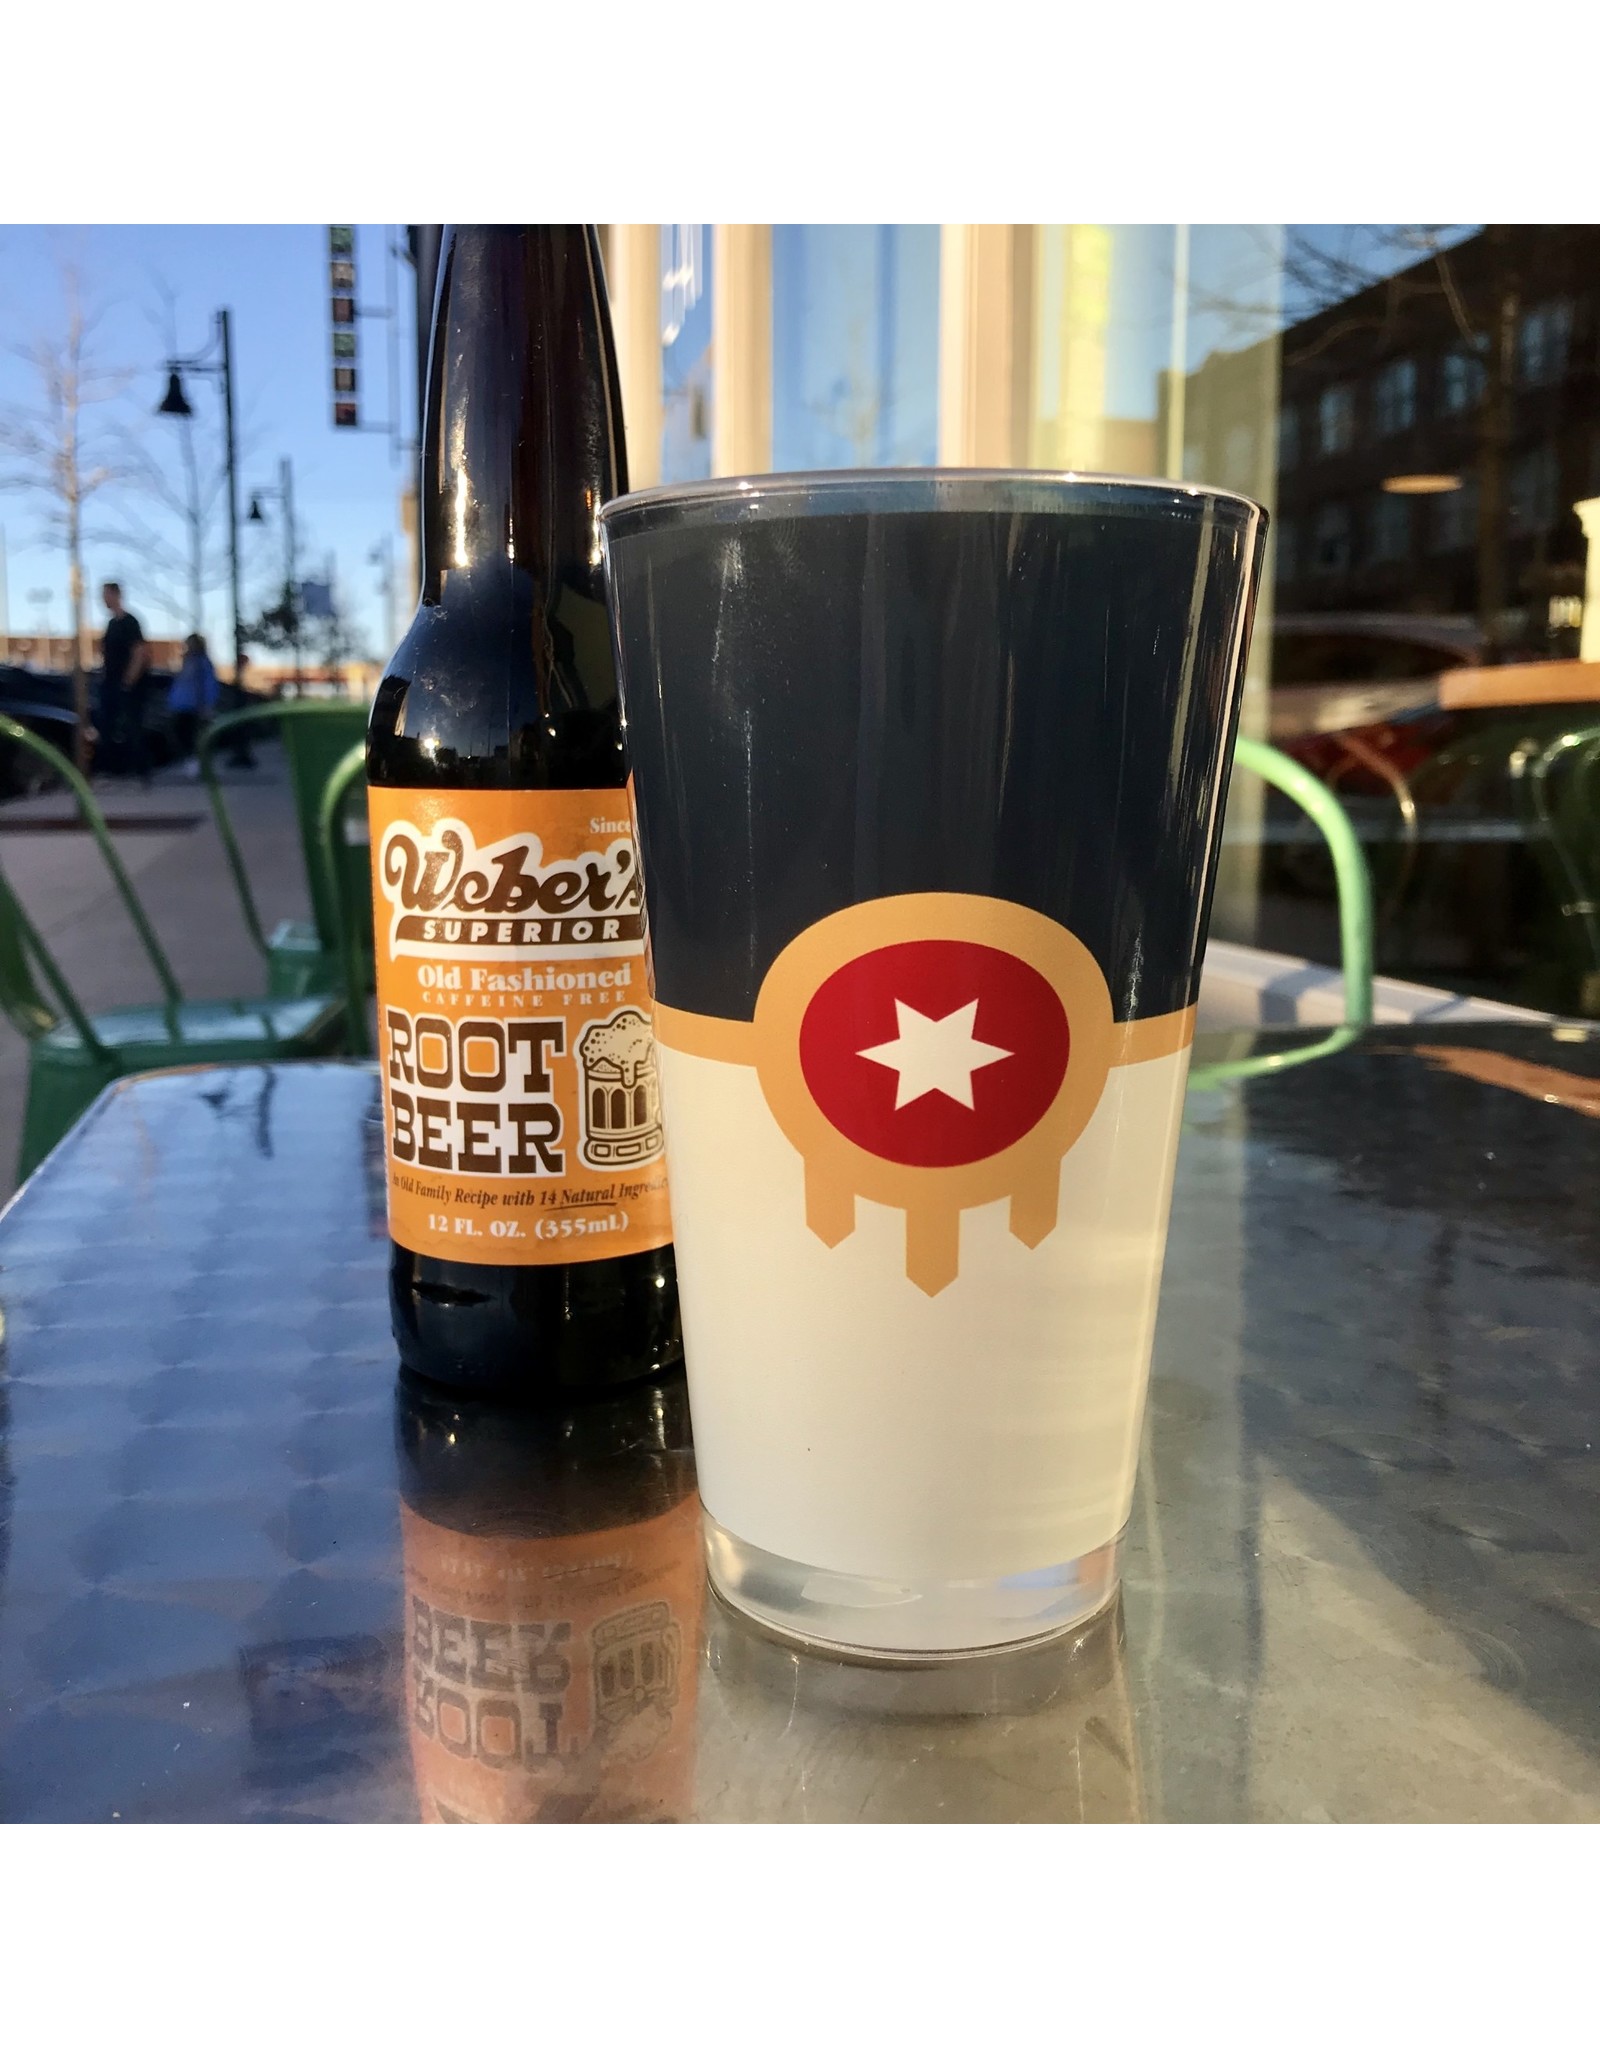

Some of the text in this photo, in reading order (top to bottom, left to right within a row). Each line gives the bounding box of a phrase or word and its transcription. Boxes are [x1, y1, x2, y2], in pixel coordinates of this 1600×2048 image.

[589, 817, 632, 834] Since
[384, 830, 641, 914] Weber's
[422, 919, 620, 943] SUPERIOR
[417, 962, 632, 992] Old Fashioned
[422, 990, 626, 1008] CAFFEINE FREE
[386, 1008, 566, 1094] ROOT
[390, 1088, 565, 1175] BEER
[401, 1175, 414, 1192] Old
[416, 1179, 452, 1206] Family
[454, 1187, 498, 1209] Recipe
[502, 1188, 535, 1206] with
[540, 1189, 557, 1206] 14
[560, 1183, 616, 1205] Natural
[428, 1210, 629, 1240] 12 FL. OZ. (355mL)
